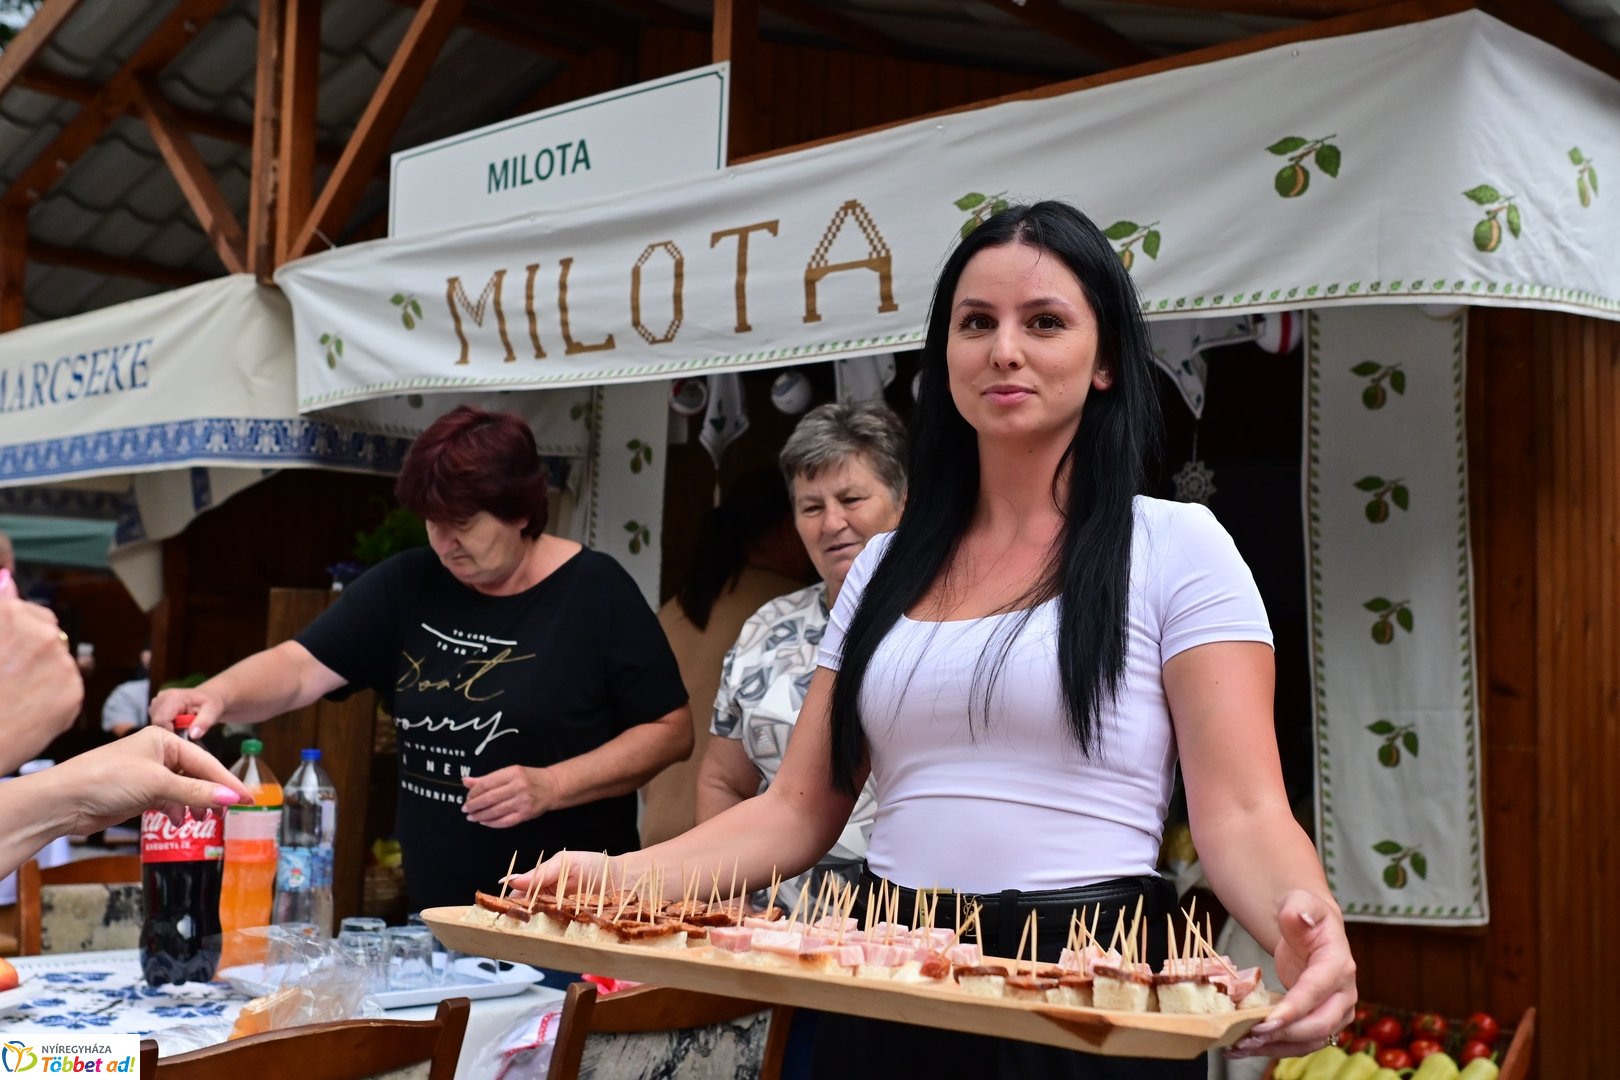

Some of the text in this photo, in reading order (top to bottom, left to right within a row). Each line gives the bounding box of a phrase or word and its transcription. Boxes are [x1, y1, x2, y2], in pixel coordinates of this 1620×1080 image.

[488, 139, 591, 194] MILOTA
[446, 199, 898, 364] MILOTA
[395, 648, 536, 701] Don't
[426, 760, 471, 778] NEW
[430, 746, 466, 757] CREATE
